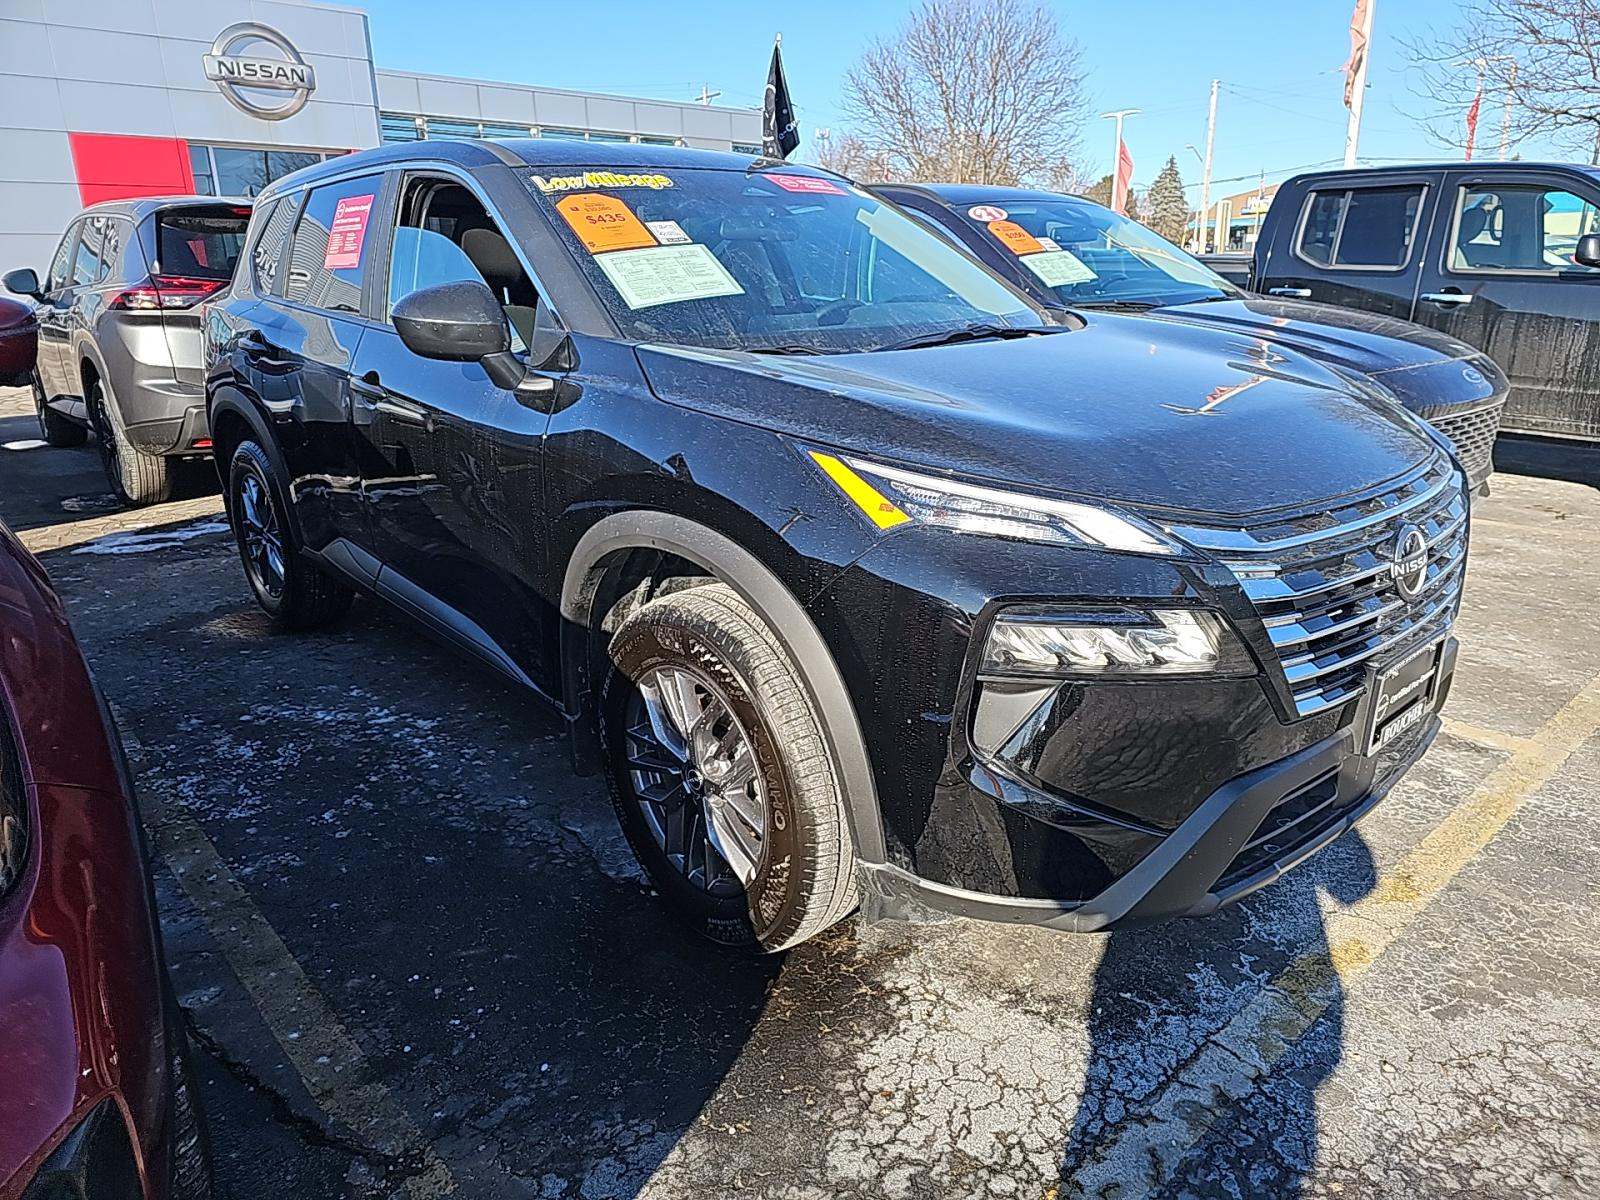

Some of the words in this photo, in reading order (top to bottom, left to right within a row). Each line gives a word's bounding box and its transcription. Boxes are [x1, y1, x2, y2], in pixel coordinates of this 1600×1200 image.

[217, 60, 305, 83] NISSAN
[530, 175, 584, 193] Low
[583, 172, 674, 190] Mileage
[585, 213, 626, 225] $435
[1394, 555, 1428, 577] NISS
[1382, 702, 1424, 743] BOUCHER
